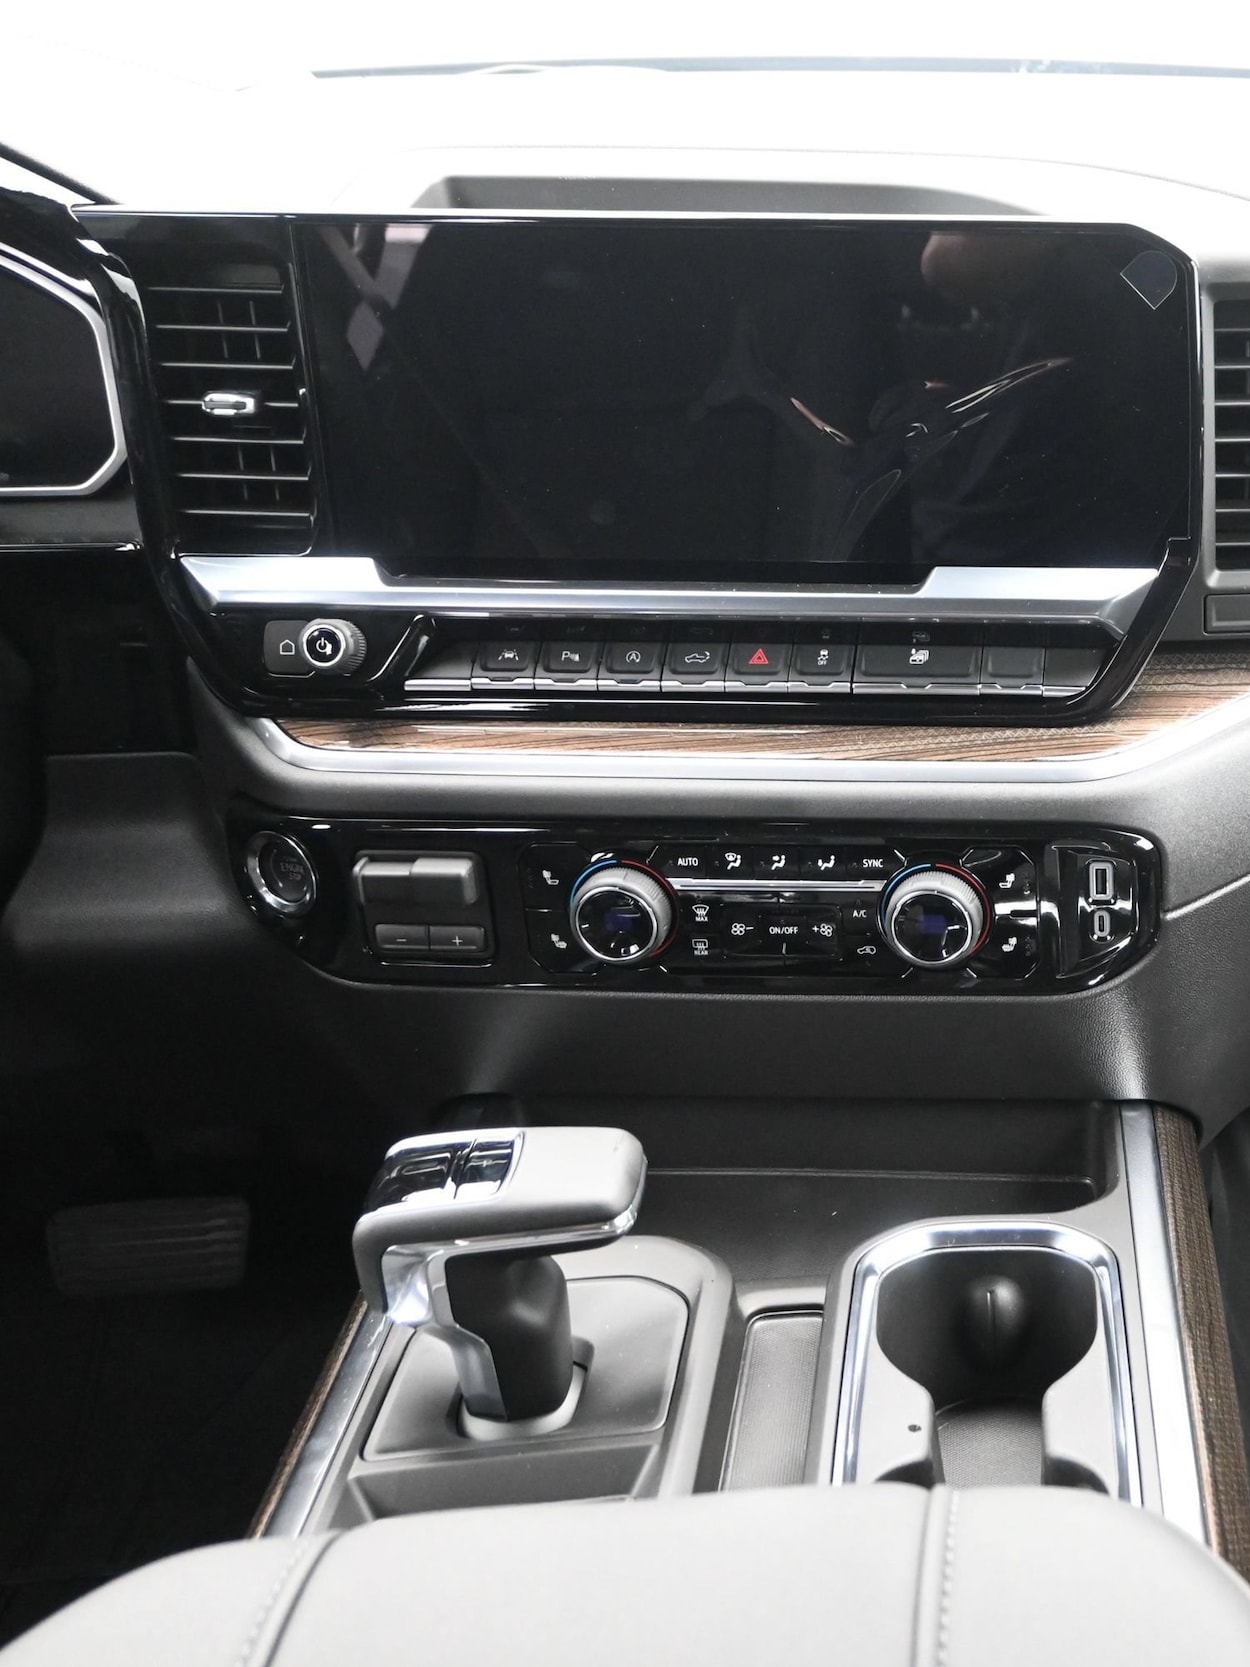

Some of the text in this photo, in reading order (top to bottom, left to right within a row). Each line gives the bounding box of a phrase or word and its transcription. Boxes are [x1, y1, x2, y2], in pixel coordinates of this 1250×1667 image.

[677, 857, 699, 867] AUTO
[862, 858, 884, 868] SYNC
[852, 909, 867, 918] A/C
[768, 926, 799, 935] ON/OFF
